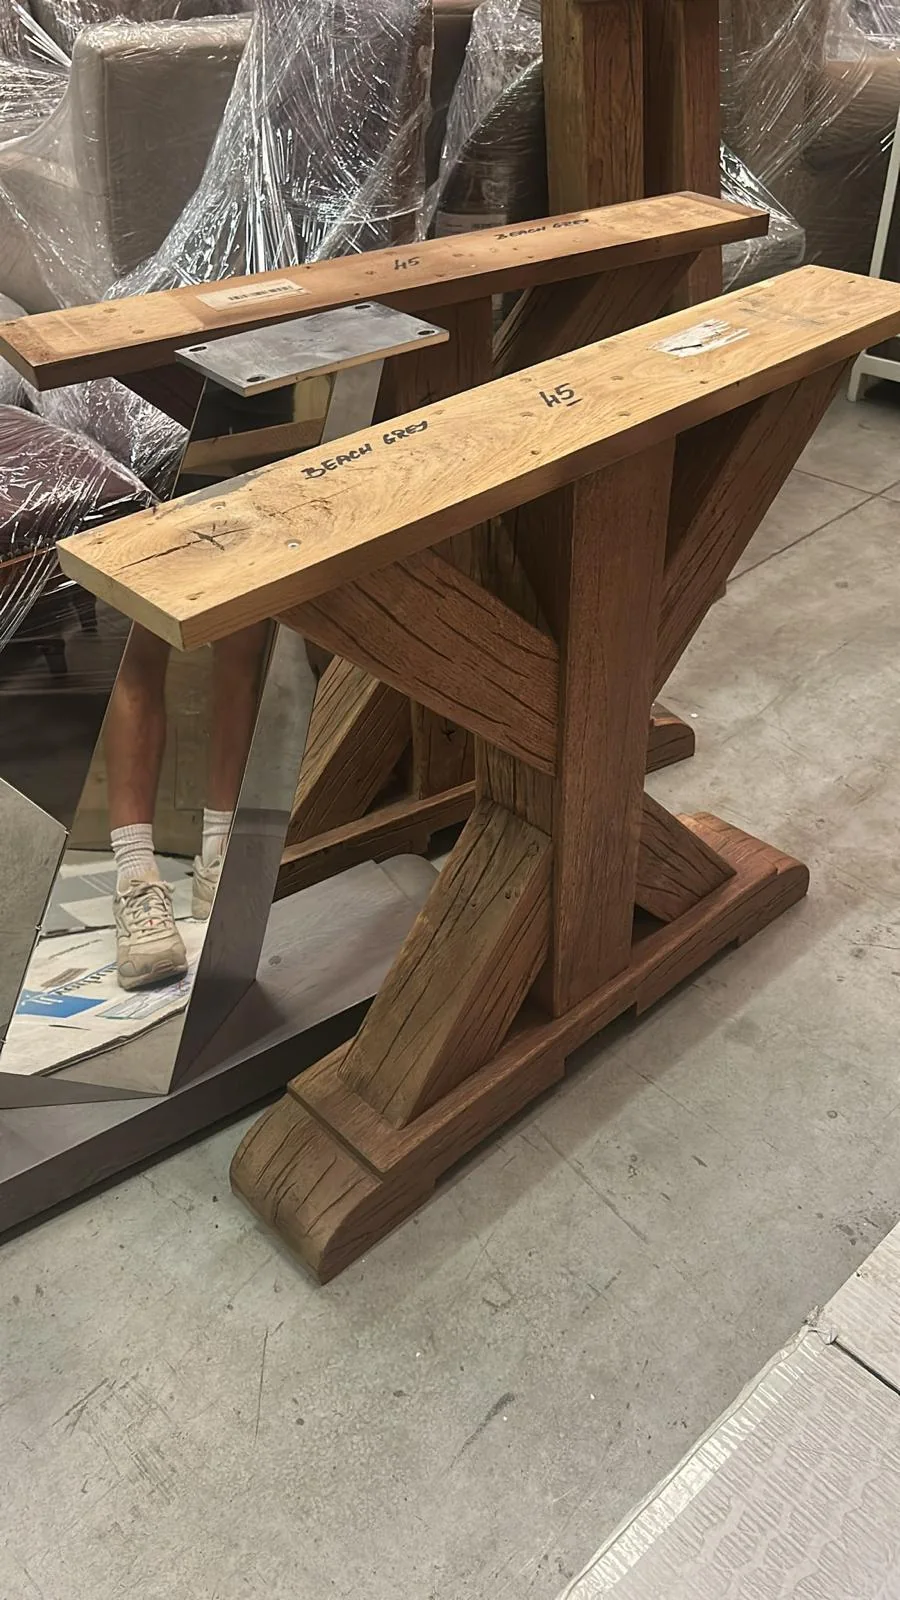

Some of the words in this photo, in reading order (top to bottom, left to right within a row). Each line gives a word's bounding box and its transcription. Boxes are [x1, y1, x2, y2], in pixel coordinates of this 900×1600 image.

[394, 256, 420, 270] 45
[539, 382, 575, 407] 45
[300, 443, 373, 480] BEACH
[382, 420, 428, 445] GREY
